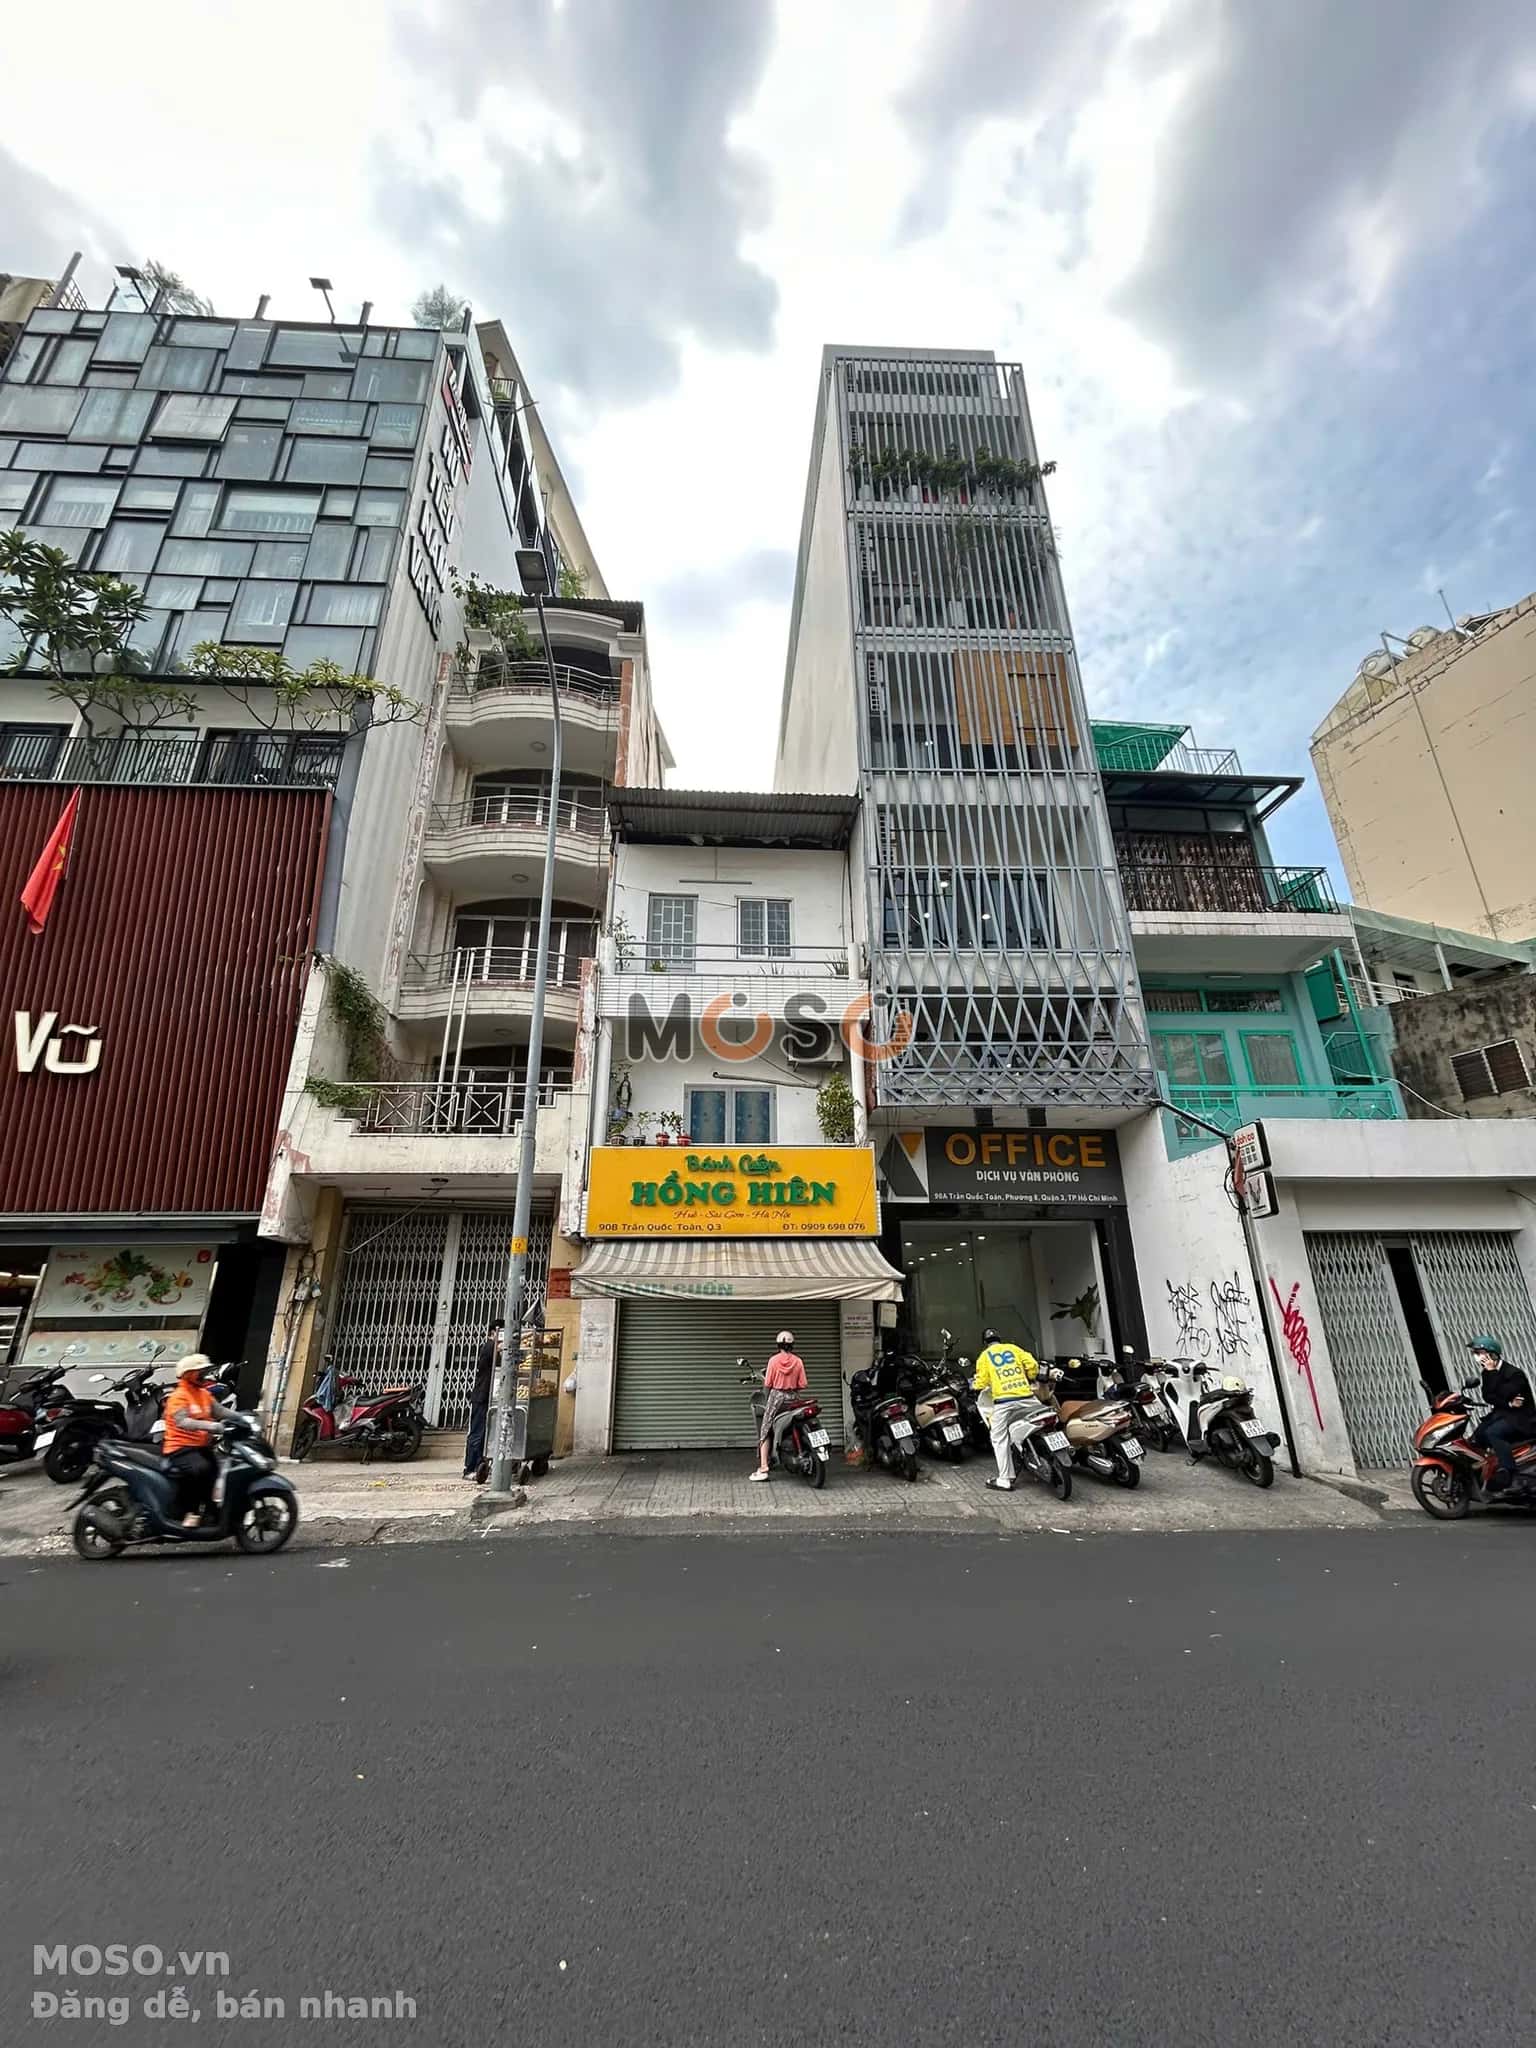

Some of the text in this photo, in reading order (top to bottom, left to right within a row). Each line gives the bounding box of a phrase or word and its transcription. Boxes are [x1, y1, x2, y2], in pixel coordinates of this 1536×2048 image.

[945, 1133, 1106, 1168] OFFICE
[685, 1155, 735, 1172] Bánh
[976, 1170, 1000, 1183] DỊCH
[1002, 1171, 1017, 1183] VỤ
[630, 1170, 837, 1207] HỒNG HIÊN
[599, 1223, 618, 1231] 90B
[801, 1223, 825, 1231] 0909
[828, 1223, 846, 1231] 698
[848, 1223, 866, 1231] 076
[987, 1350, 1016, 1367] be
